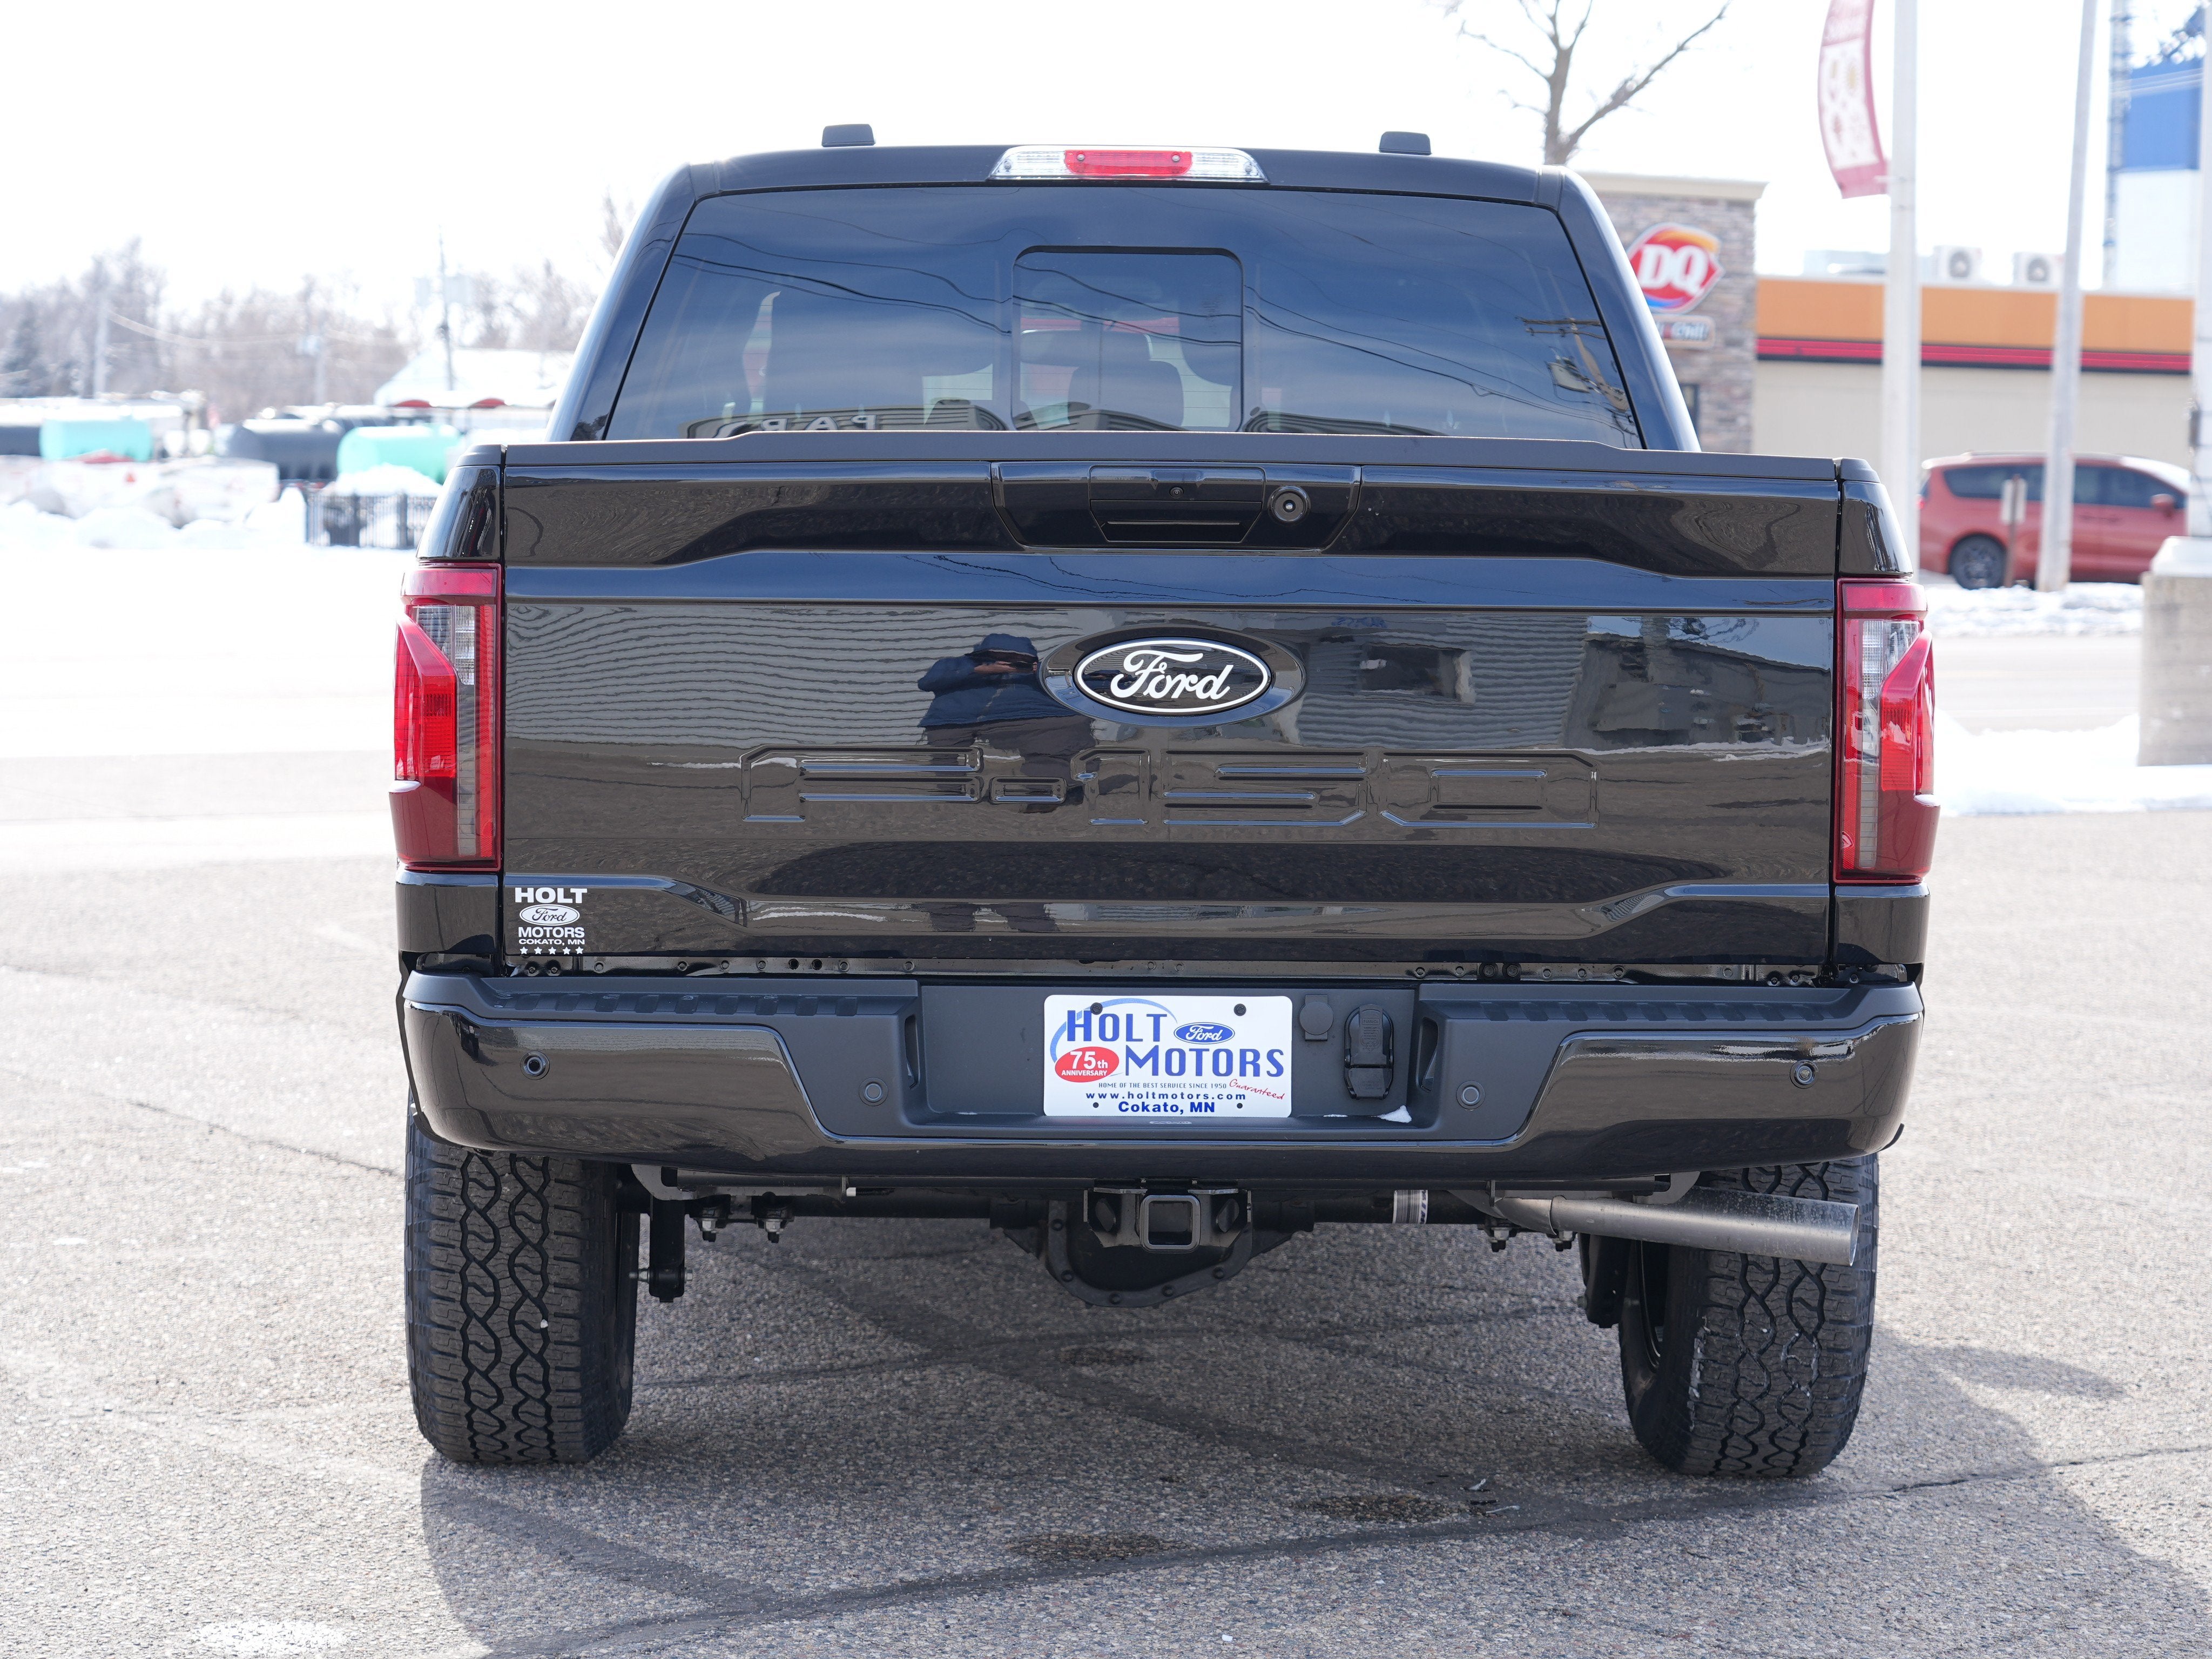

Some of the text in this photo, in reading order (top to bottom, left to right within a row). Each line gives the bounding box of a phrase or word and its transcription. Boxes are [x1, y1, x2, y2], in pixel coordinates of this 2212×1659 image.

[1638, 244, 1709, 296] DQ
[1110, 650, 1233, 699] Ford
[740, 744, 1599, 828] F-150
[515, 887, 588, 903] HOLT
[532, 907, 567, 921] Ford
[518, 927, 585, 938] MOTORS
[1067, 1010, 1167, 1042] HOLT
[1185, 1026, 1222, 1041] Ford
[1070, 1051, 1108, 1069] 75th
[1125, 1044, 1284, 1077] MOTORS
[1086, 1091, 1246, 1100] www.holtmotors.com
[1229, 1078, 1285, 1100] Guaranteed
[1118, 1101, 1215, 1115] Cokato, MN
